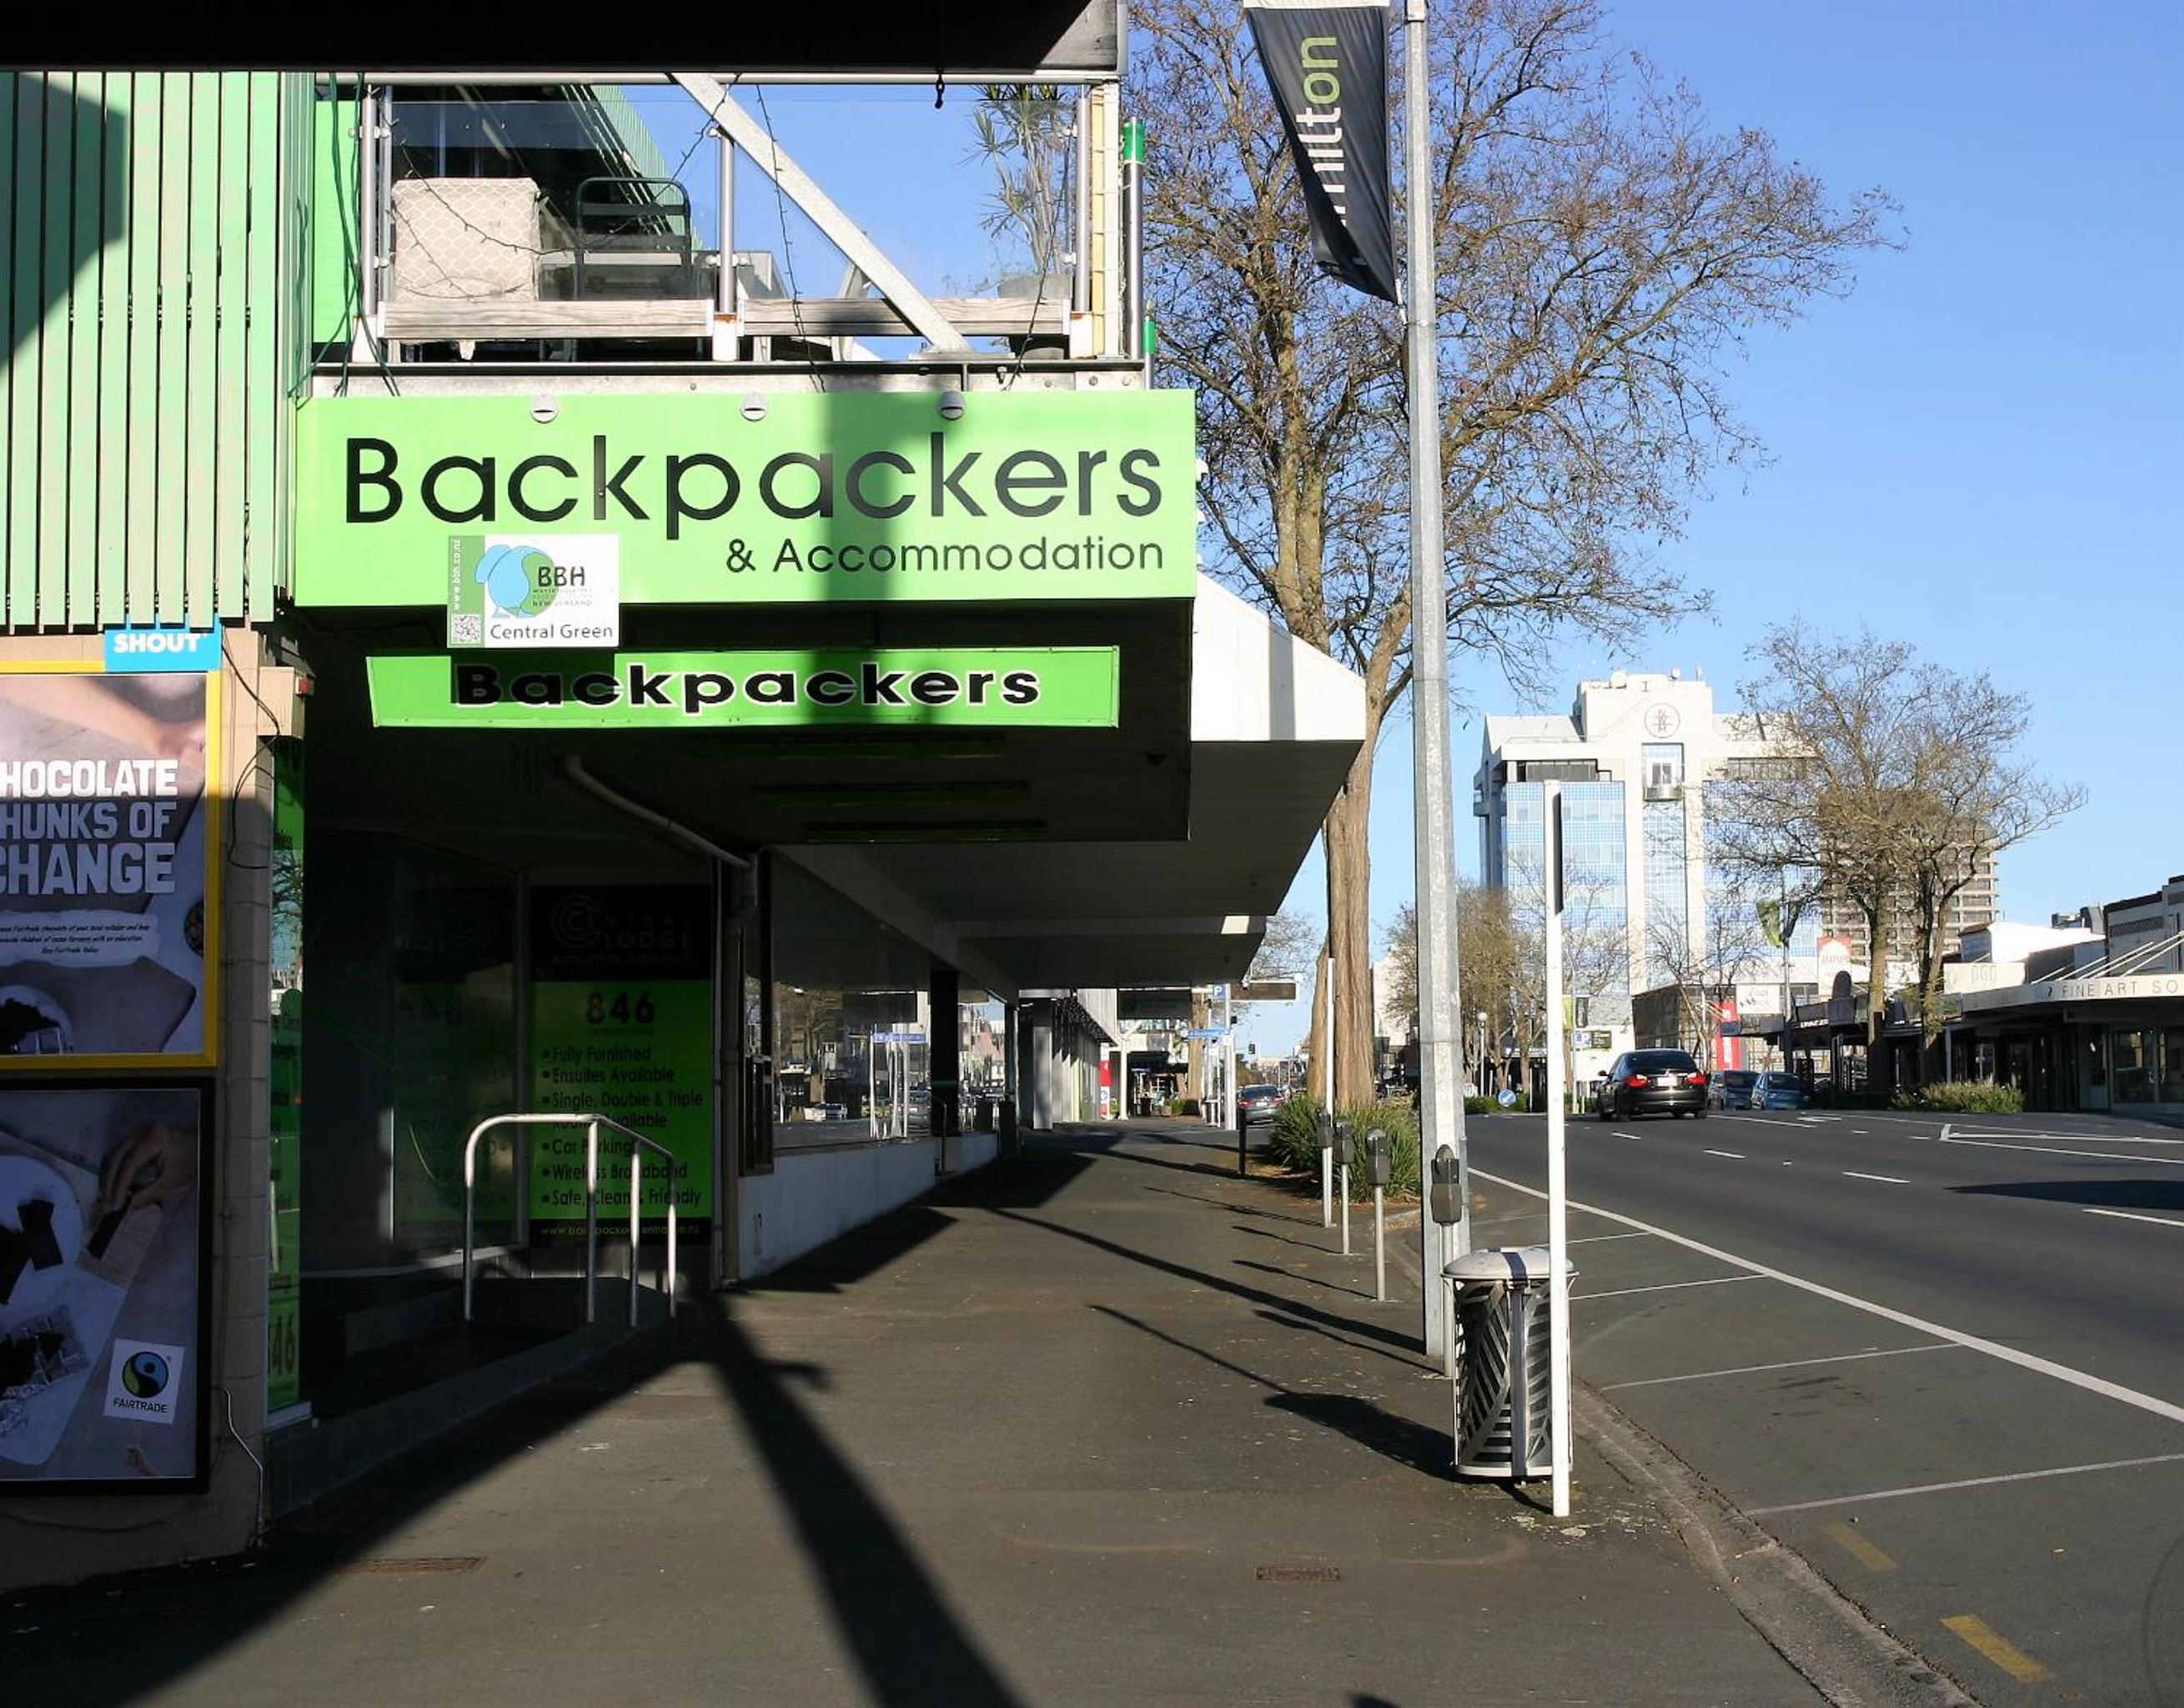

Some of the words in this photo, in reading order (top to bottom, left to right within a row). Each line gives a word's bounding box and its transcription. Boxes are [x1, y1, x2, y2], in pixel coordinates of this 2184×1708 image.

[346, 432, 1162, 540] Backpackers
[726, 539, 757, 572] &
[773, 536, 1162, 572] Accommodation
[538, 566, 585, 587] BBH
[490, 624, 555, 639] Central
[560, 624, 614, 639] Green
[113, 632, 202, 654] SHOUT
[456, 663, 1041, 716] Backpackers
[129, 801, 178, 839] OF
[0, 841, 176, 896] HANGE
[2062, 984, 2096, 998] FINE
[2105, 982, 2136, 996] ART
[587, 990, 655, 1025] 846
[553, 1047, 583, 1064] Fully
[588, 1046, 651, 1062] Furnished
[553, 1068, 606, 1083] Ensuites
[611, 1067, 675, 1083] Available
[602, 1092, 650, 1108] Double
[668, 1090, 704, 1108] Triple
[553, 1138, 577, 1154] Car
[113, 1398, 168, 1414] FAIRTRADE
